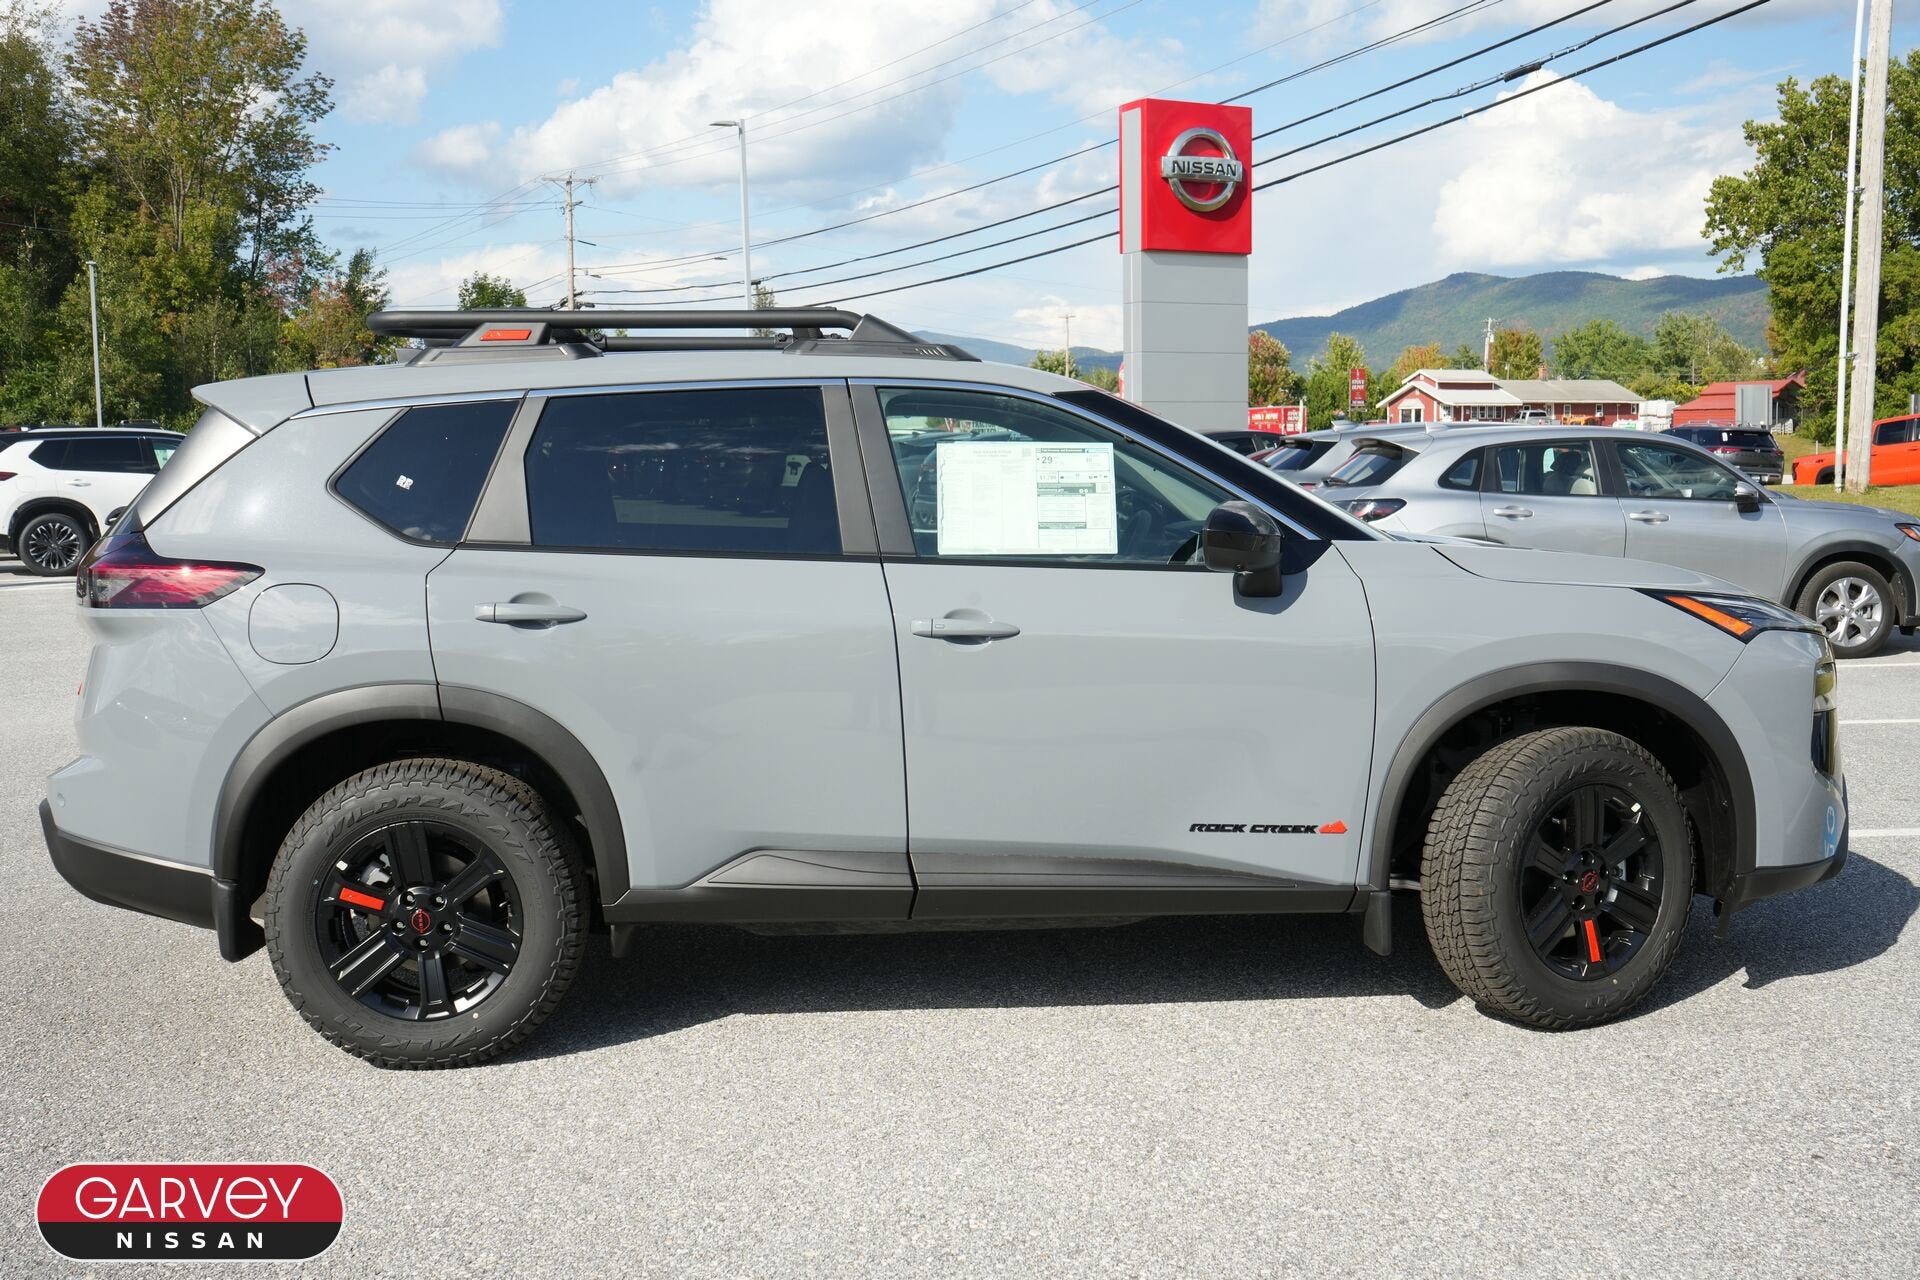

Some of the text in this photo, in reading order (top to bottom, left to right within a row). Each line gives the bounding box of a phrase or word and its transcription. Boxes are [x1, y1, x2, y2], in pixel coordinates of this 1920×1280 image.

[1172, 160, 1237, 176] NISSAN
[1041, 456, 1053, 464] 29
[1189, 823, 1319, 834] ROCK CREEK
